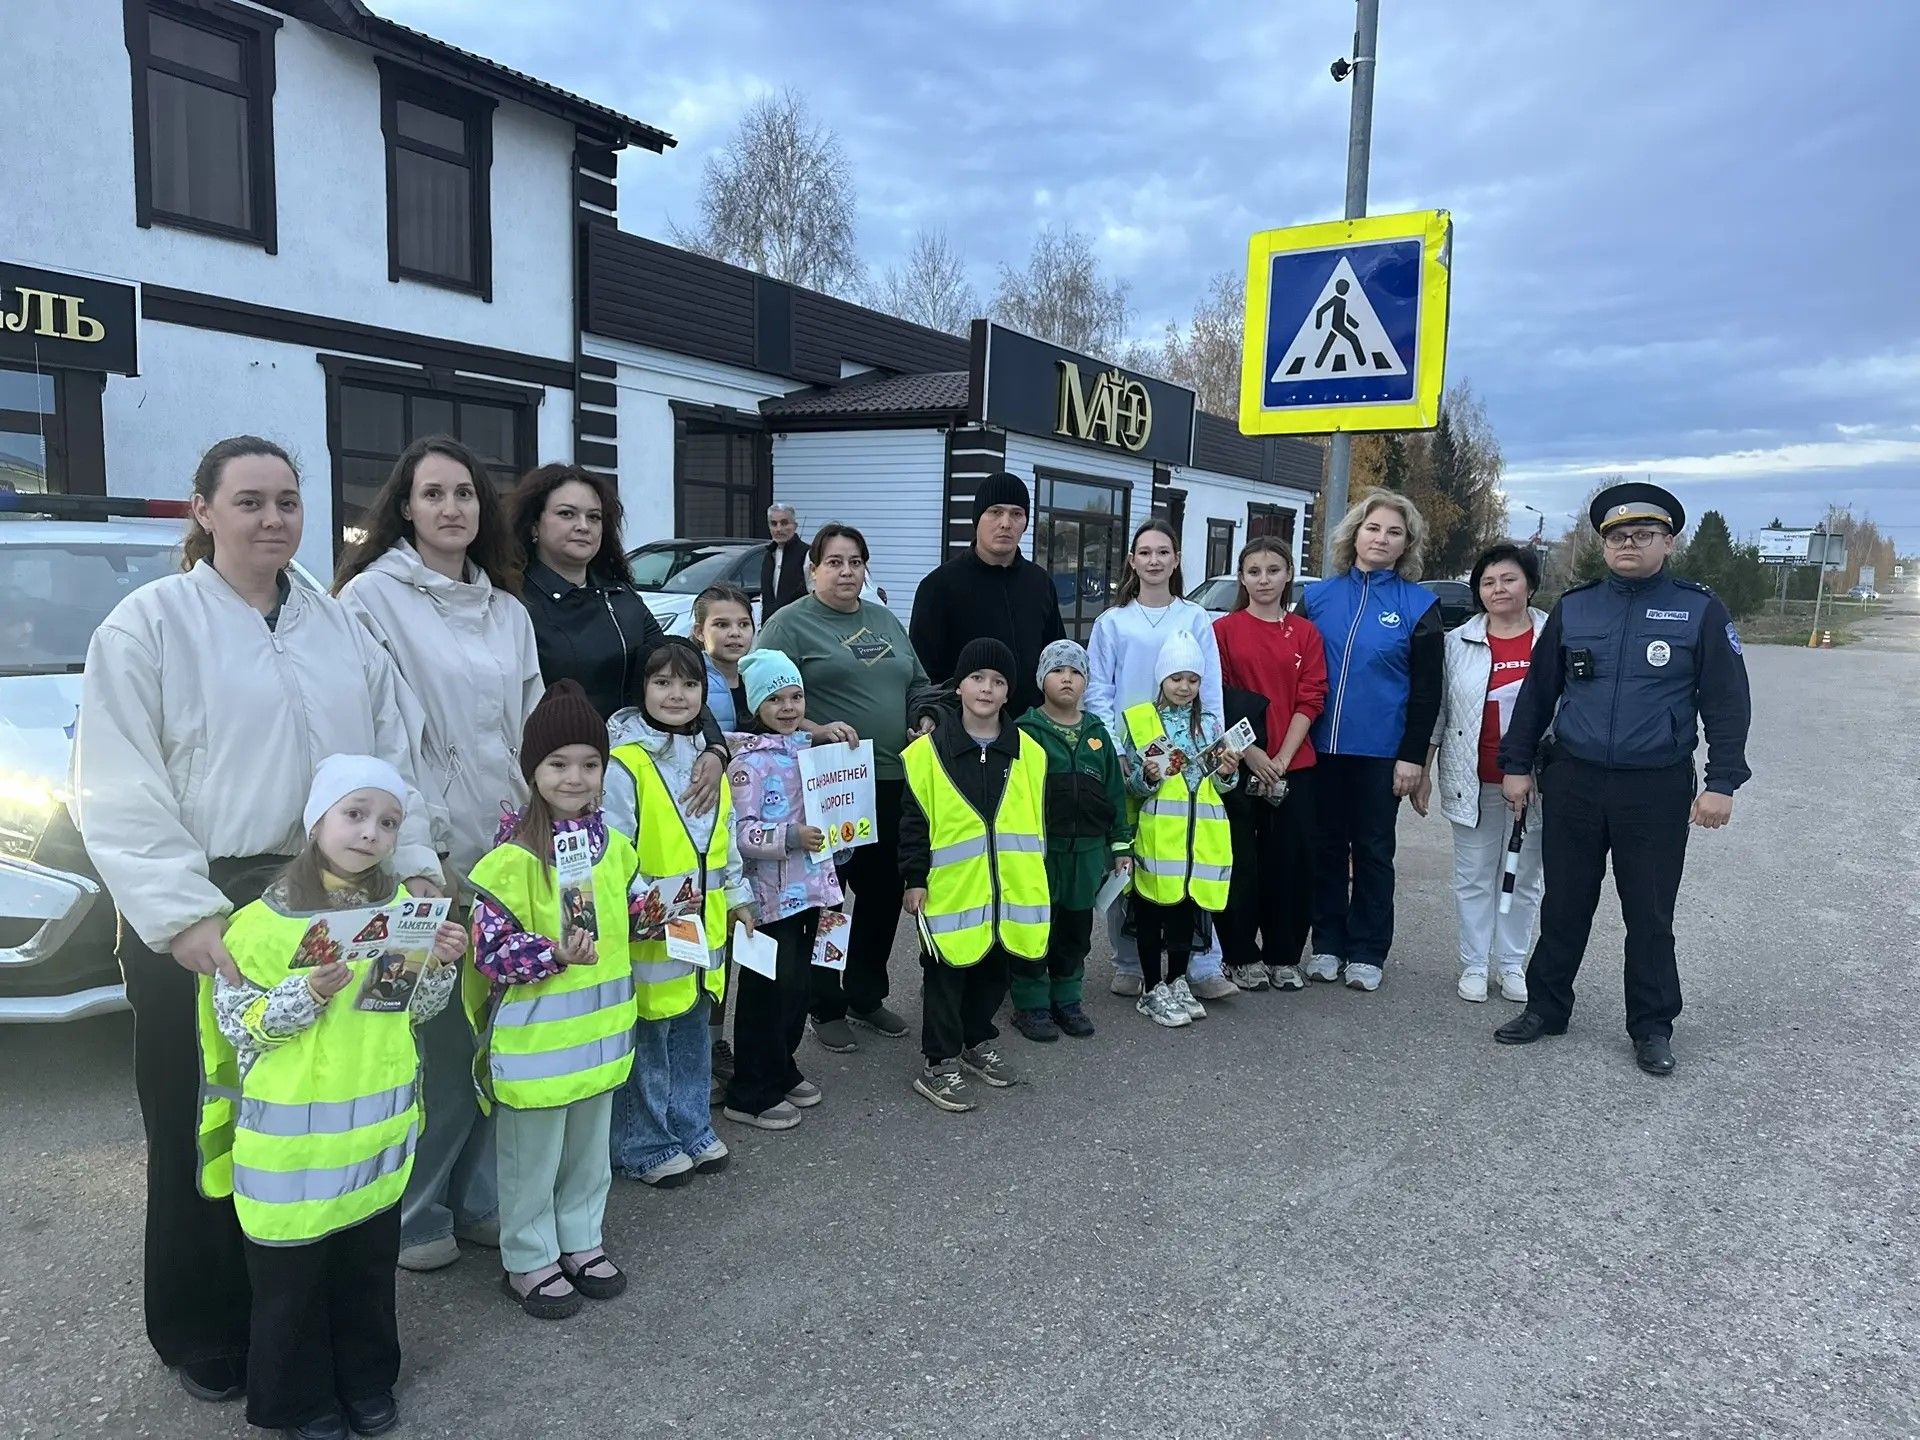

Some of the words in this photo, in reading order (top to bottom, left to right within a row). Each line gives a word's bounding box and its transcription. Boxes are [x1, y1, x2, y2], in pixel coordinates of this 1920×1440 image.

[0, 286, 105, 342] ЛЬ
[1648, 610, 1663, 618] ДПС
[1664, 611, 1687, 619] ГИБДД
